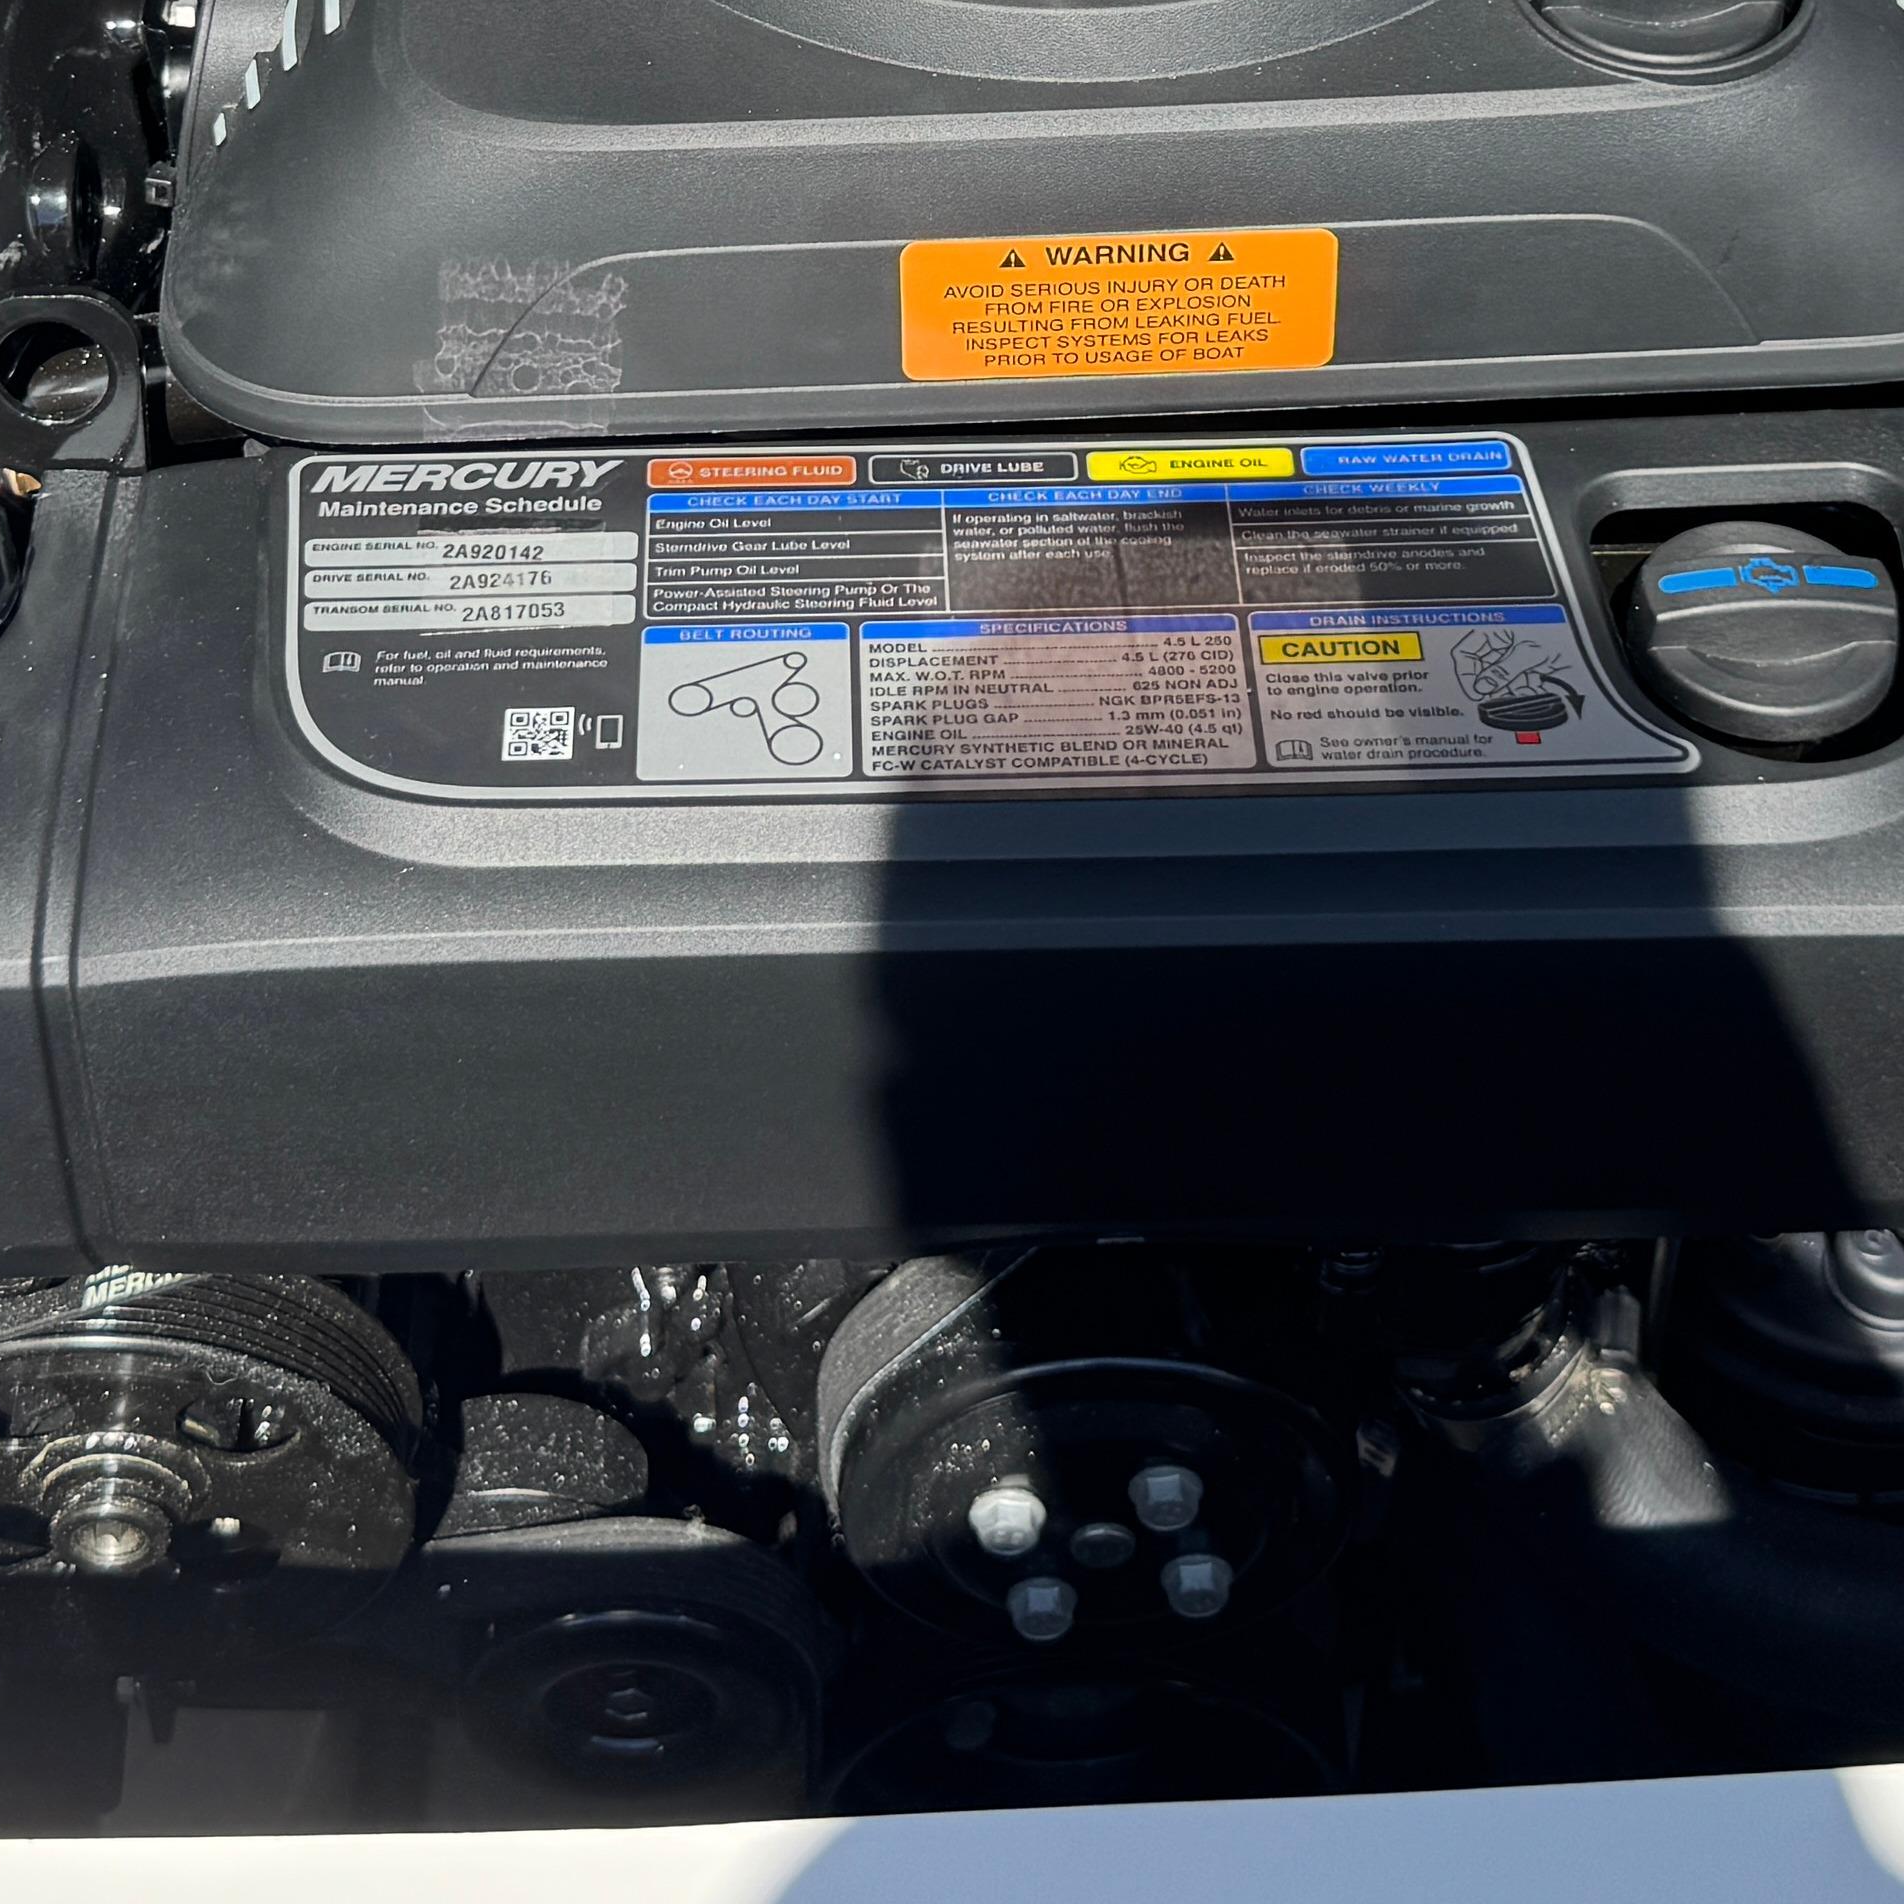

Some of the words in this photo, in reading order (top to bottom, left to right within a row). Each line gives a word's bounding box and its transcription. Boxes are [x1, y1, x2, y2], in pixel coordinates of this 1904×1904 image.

[1046, 243, 1190, 266] WARNING
[944, 284, 1003, 297] AVOID
[1011, 282, 1100, 296] SERIOUS
[1107, 279, 1178, 294] INJURY
[1184, 278, 1213, 292] OR
[1220, 275, 1286, 290] DEATH
[985, 303, 1042, 315] FROM
[1050, 301, 1093, 313] FIRE
[1101, 299, 1129, 312] OR
[1136, 295, 1250, 311] EXPLOSION
[952, 319, 1063, 333] RESULTING
[1070, 317, 1128, 330] FROM
[1135, 314, 1219, 328] LEAKING
[1227, 312, 1281, 326] FUEL.
[966, 336, 1050, 350] INSPECT
[1057, 333, 1151, 348] SYSTEMS
[1159, 332, 1198, 345] FOR
[1205, 329, 1268, 343] LEAKS
[984, 354, 1045, 367] PRIOR
[1052, 353, 1078, 364] TO
[1085, 350, 1153, 363] USAGE
[1160, 349, 1186, 361] OF
[1193, 347, 1244, 360] BOAT
[1170, 460, 1234, 469] ENGINE
[1240, 458, 1267, 468] OIL
[1338, 456, 1377, 464] RAW
[1383, 454, 1443, 463] WATER
[1448, 452, 1503, 462] DRAIN
[311, 460, 624, 493] MERCURY
[700, 466, 787, 477] STEERING
[793, 465, 842, 476] FLUID
[941, 463, 992, 474] DRIVE
[997, 462, 1044, 473] LUBE
[988, 492, 1047, 502] CHECK
[1054, 490, 1102, 501] EACH
[1108, 489, 1140, 499] DAY
[1147, 488, 1182, 498] END
[1304, 484, 1362, 495] CHECK
[1369, 482, 1440, 493] WEEKLY
[319, 500, 478, 518] Maintenance
[485, 496, 602, 513] Schedule
[688, 497, 746, 507] CHECK
[754, 496, 803, 506] EACH
[808, 495, 843, 505] DAY
[847, 493, 902, 504] START
[655, 519, 705, 530] Engine
[710, 518, 729, 528] Oil
[734, 518, 771, 528] Level
[313, 543, 363, 552] ENGINE
[366, 542, 412, 550] SERIAL
[416, 541, 438, 549] NO.
[442, 545, 544, 561] 2A920142
[655, 541, 728, 553] Sterndrive
[732, 541, 767, 551] Gear
[772, 540, 807, 550] Lube
[812, 540, 850, 550] Level
[655, 566, 686, 577] Trim
[690, 565, 732, 577] Pump
[737, 565, 756, 575] Oil
[761, 564, 799, 575] Level
[313, 574, 352, 582] DRIVE
[356, 573, 404, 581] SERIAL
[407, 572, 430, 581] NO.
[450, 571, 551, 589] 2A924176
[653, 587, 765, 599] Power-Assisted
[770, 585, 830, 597] Steering
[834, 584, 877, 596] Pump
[881, 584, 898, 594] Or
[903, 583, 931, 594] The
[314, 605, 379, 615] TRANSOM
[383, 604, 430, 613] SERIAL
[434, 603, 456, 612] NO.
[462, 602, 565, 622] 2A817053
[653, 600, 718, 613] Compact
[722, 600, 790, 611] Hydraulic
[795, 598, 855, 610] Steering
[859, 597, 894, 607] Fluid
[898, 596, 937, 606] Level
[980, 621, 1127, 635] SPECIFICATIONS
[1309, 615, 1366, 627] DRAIN
[1371, 612, 1505, 625] INSTRUCTIONS
[680, 629, 724, 640] BELT
[730, 628, 811, 639] ROUTING
[869, 643, 928, 653] MODEL
[1164, 637, 1185, 646] 4.5
[1191, 637, 1200, 646] L
[1205, 636, 1232, 645] 250
[1281, 639, 1400, 658] CAUTION
[870, 655, 998, 668] DISPLACEMENT
[1122, 652, 1144, 662] 4.5
[1149, 652, 1158, 661] L
[1201, 650, 1234, 661] CID)
[870, 672, 910, 682] MAX.
[915, 671, 965, 681] W.O.T.
[970, 670, 1005, 679] RPM
[1149, 666, 1184, 675] 4800
[1200, 665, 1236, 674] 5200
[1265, 673, 1309, 683] Close
[1314, 672, 1342, 682] this
[1346, 671, 1388, 681] valve
[1392, 669, 1428, 684] prior
[871, 687, 906, 696] IDLE
[913, 686, 947, 695] RPM
[954, 685, 969, 695] IN
[975, 683, 1054, 694] NEUTRAL
[1133, 681, 1160, 691] 625
[1165, 680, 1200, 689] NON
[1206, 679, 1238, 689] ADJ
[1267, 686, 1281, 695] to
[1287, 685, 1340, 696] engine
[1344, 683, 1422, 696] operation.
[871, 701, 927, 711] SPARK
[932, 699, 989, 710] PLUGS
[1099, 696, 1135, 706] NGK
[871, 716, 927, 726] SPARK
[933, 715, 978, 724] PLUG
[984, 713, 1019, 724] GAP
[1109, 711, 1130, 720] 1.3
[1136, 712, 1164, 720] mm
[1170, 709, 1215, 720] (0.051
[1222, 709, 1241, 719] in)
[1271, 710, 1292, 720] No
[1297, 710, 1322, 719] red
[1327, 708, 1380, 718] should
[1386, 708, 1405, 717] be
[1409, 706, 1464, 716] visible.
[872, 730, 934, 741] ENGINE
[940, 730, 967, 739] OIL
[1126, 725, 1183, 735] 25W-40
[1189, 724, 1216, 735] (4.5
[1222, 723, 1242, 734] qt)
[872, 745, 954, 756] MERCURY
[960, 743, 1054, 754] SYNTHETIC
[1061, 740, 1117, 753] BLEND
[1123, 740, 1146, 750] OR
[1153, 738, 1229, 749] MINERAL
[873, 760, 916, 771] FC-W
[921, 758, 1007, 770] CATALYST
[1012, 756, 1119, 769] COMPATIBLE
[1125, 754, 1208, 767] (4-CYCLE)
